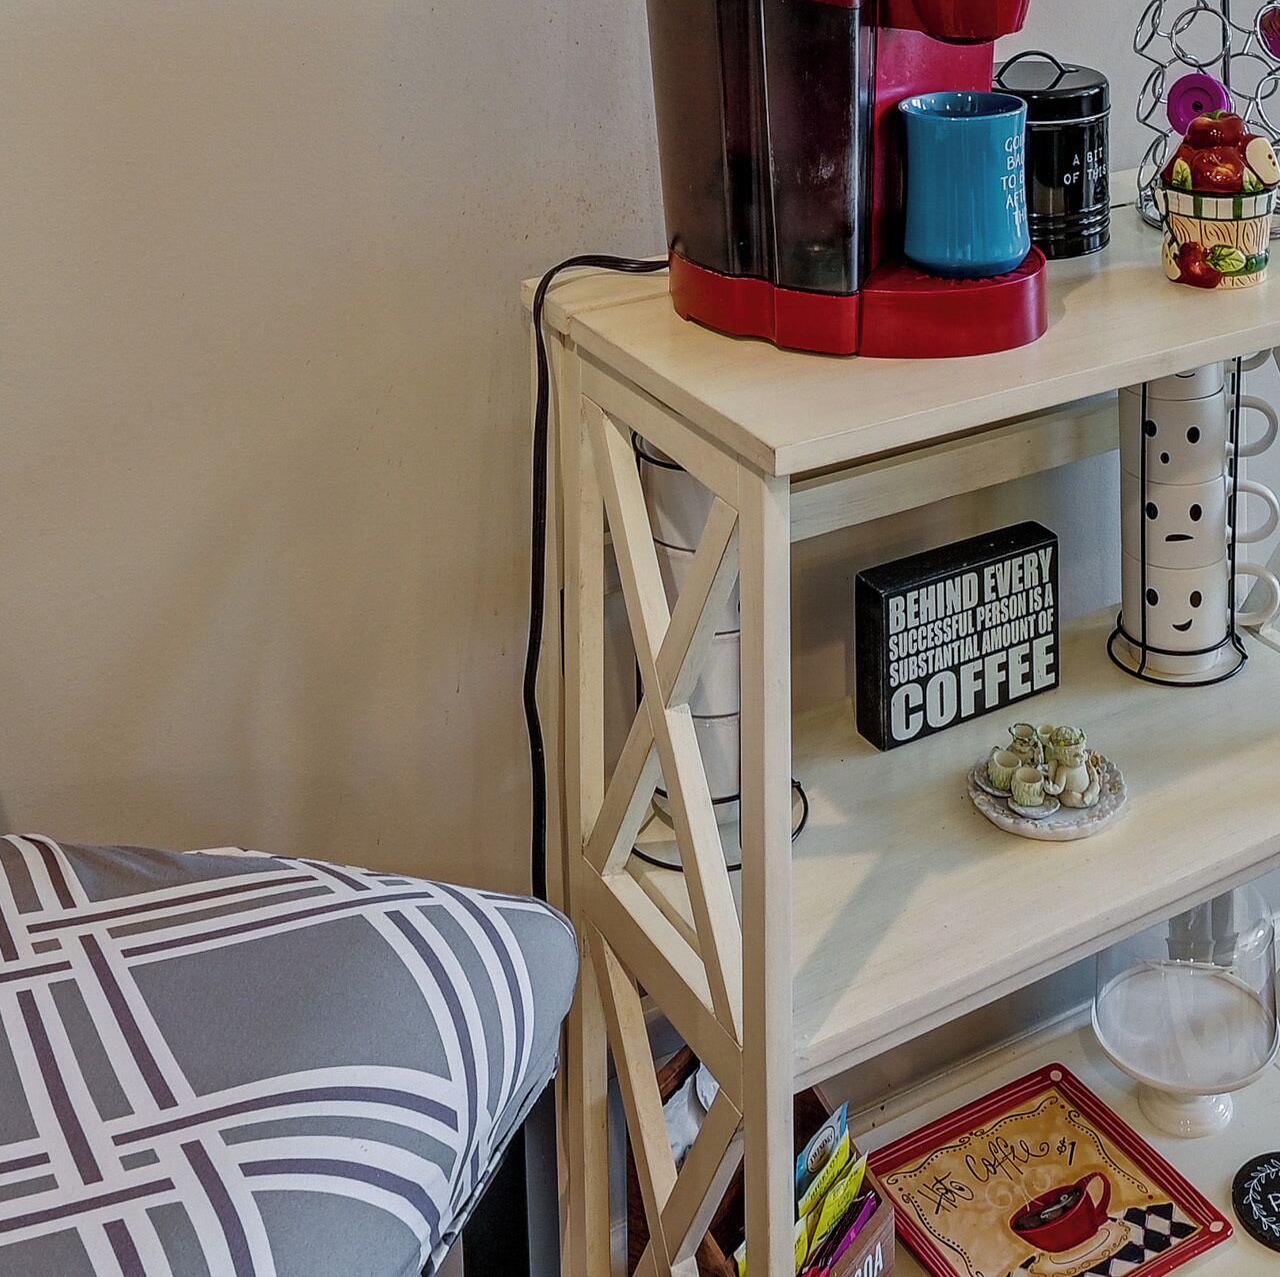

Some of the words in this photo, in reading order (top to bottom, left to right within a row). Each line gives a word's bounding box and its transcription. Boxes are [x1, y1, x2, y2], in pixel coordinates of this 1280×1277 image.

[1000, 173, 1017, 191] TO
[1063, 171, 1080, 185] OF
[1086, 163, 1107, 182] THIS
[1072, 153, 1081, 166] A
[1086, 146, 1104, 163] BIT
[889, 572, 980, 635] BEHIND
[983, 546, 1053, 604] EVERY
[889, 610, 975, 662] SUCCESSFUL
[976, 591, 1026, 631] PERSON
[1028, 587, 1043, 613] IS
[1043, 582, 1054, 608] A
[889, 636, 980, 688] SUBSTANTIAL
[981, 616, 1037, 656] AMOUNT
[1038, 608, 1054, 633] OF
[890, 634, 1056, 742] COFFEE
[917, 1171, 974, 1215] Hot
[965, 1136, 1049, 1183] Coffee
